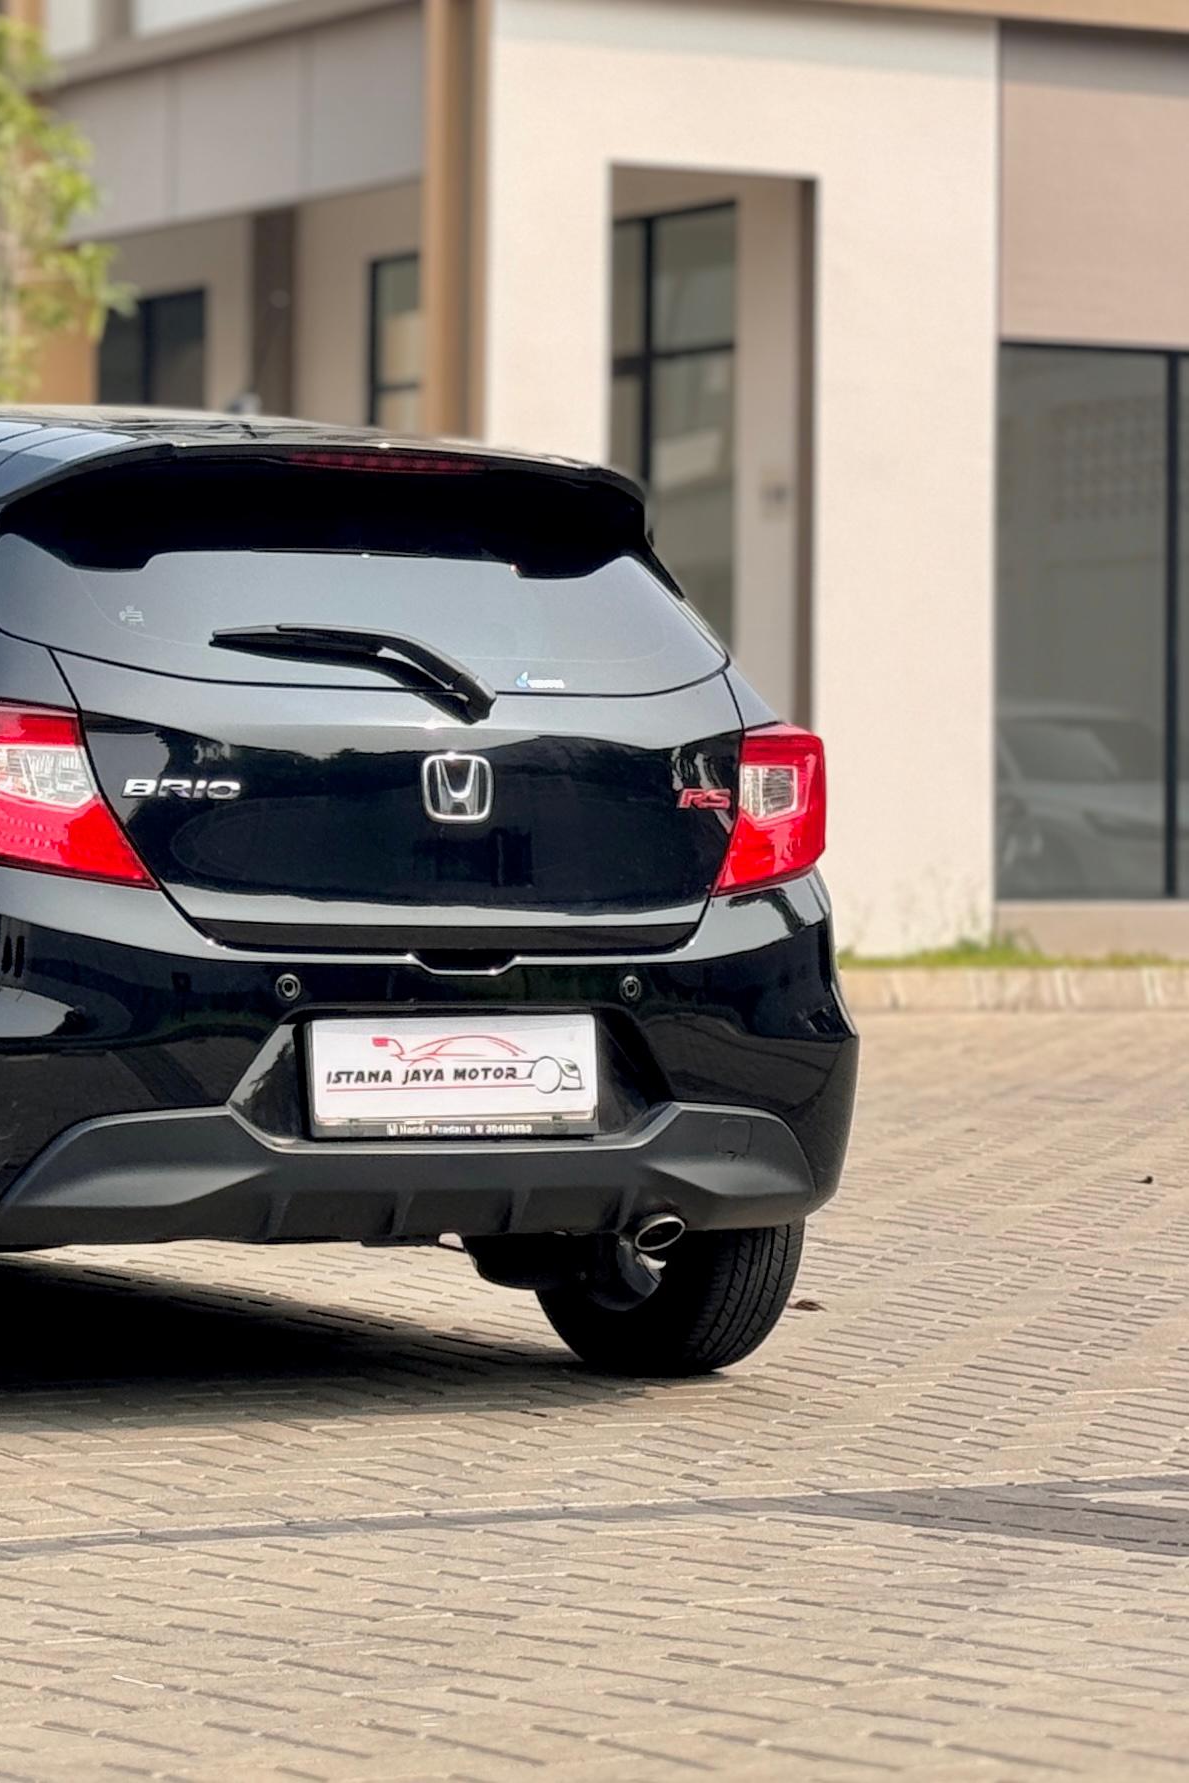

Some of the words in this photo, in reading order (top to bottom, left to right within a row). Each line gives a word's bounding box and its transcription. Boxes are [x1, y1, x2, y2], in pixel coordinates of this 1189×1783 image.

[122, 778, 241, 800] BRIO
[676, 788, 731, 809] RS
[326, 1069, 392, 1084] ISTANA
[402, 1068, 444, 1085] JAYA
[453, 1067, 517, 1081] MOTOR
